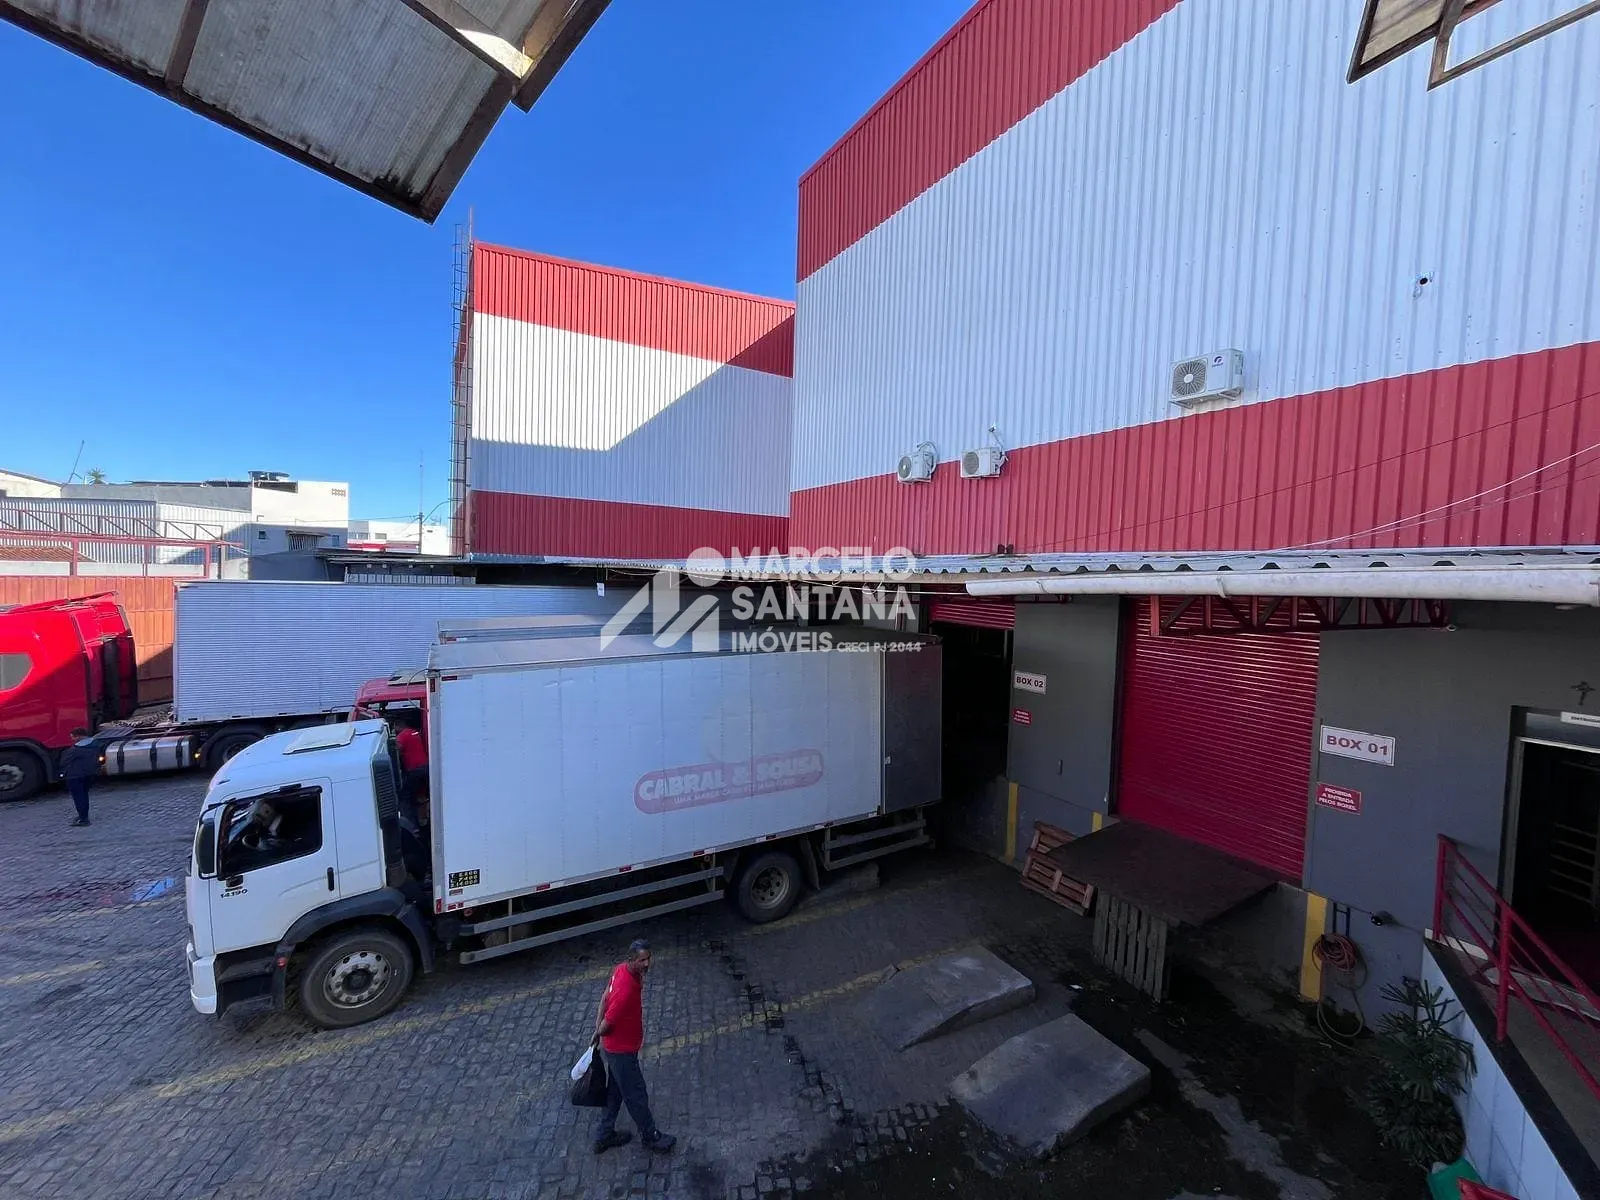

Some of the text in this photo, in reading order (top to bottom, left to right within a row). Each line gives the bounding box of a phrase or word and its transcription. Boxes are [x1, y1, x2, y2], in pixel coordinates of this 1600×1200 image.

[1016, 676, 1044, 688] BOX 02
[1326, 735, 1388, 756] BOX 01
[639, 769, 726, 801] CABRAL
[756, 753, 823, 781] SOUSA
